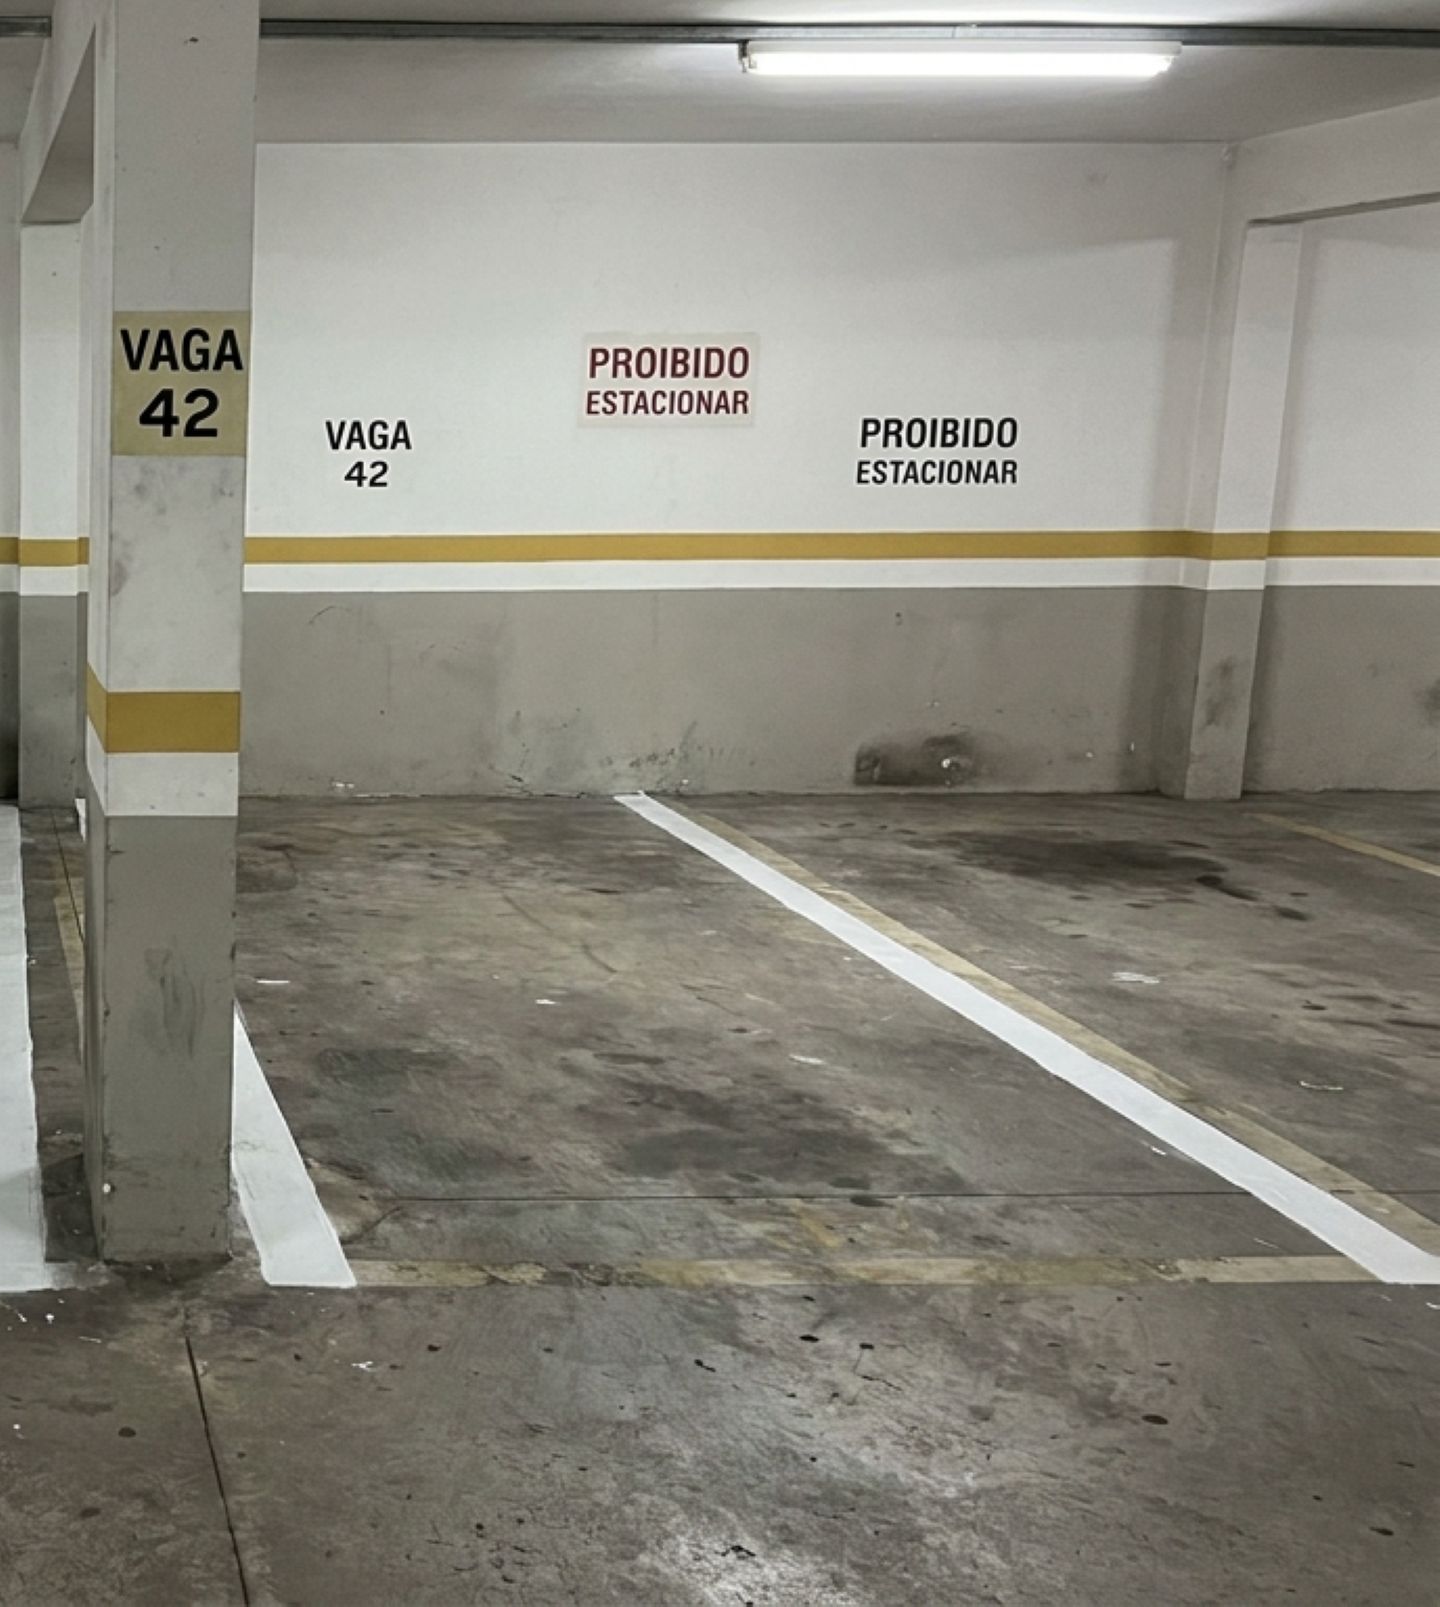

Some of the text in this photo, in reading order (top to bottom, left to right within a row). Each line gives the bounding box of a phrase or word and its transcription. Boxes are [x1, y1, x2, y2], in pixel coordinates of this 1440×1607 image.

[120, 328, 244, 372] VAGA
[589, 346, 750, 379] PROIBIDO
[139, 388, 219, 437] 42
[586, 390, 750, 415] ESTACIONAR
[325, 420, 412, 450] VAGA
[860, 417, 1018, 449] PROIBIDO
[344, 461, 388, 487] 42
[857, 459, 1018, 485] ESTACIONAR
